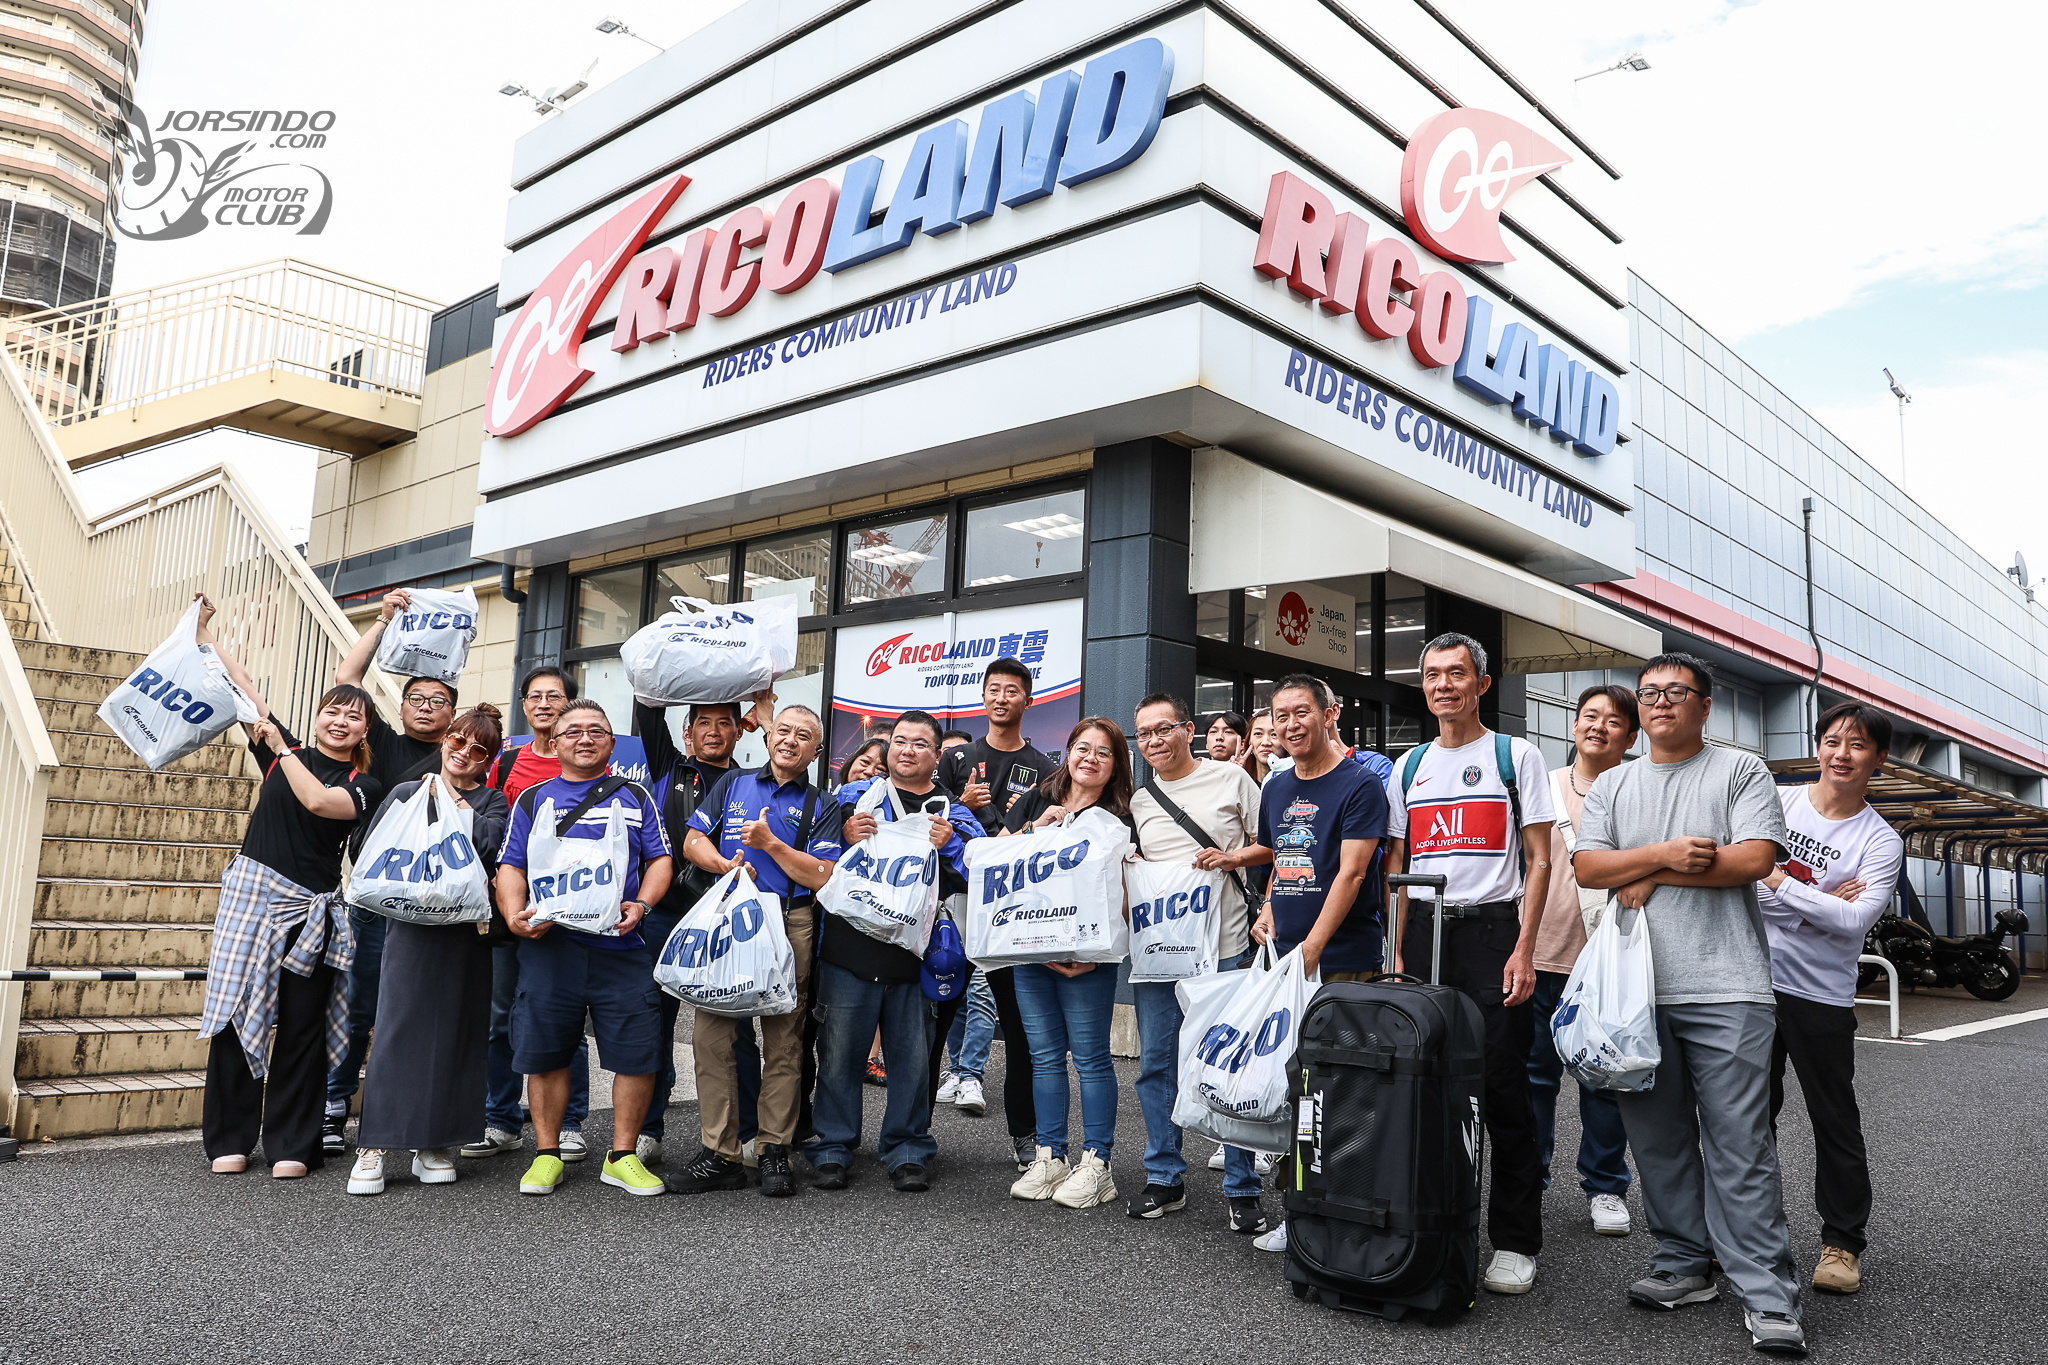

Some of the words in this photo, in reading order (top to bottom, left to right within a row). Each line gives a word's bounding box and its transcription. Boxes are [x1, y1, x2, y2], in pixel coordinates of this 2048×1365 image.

[610, 37, 1175, 354] RICOLAND
[703, 342, 776, 389] RIDERS
[781, 287, 939, 364] COMMUNITY
[940, 263, 1017, 313] LAND
[1253, 170, 1620, 457] RICOLAND
[1284, 349, 1387, 430] RIDERS
[1395, 405, 1540, 502] COMMUNITY
[1543, 473, 1593, 528] LAND
[400, 611, 472, 633] RICO
[1320, 604, 1347, 622] Japan.
[1317, 620, 1347, 639] Tax-free
[413, 647, 448, 660] RICOLAND
[899, 638, 995, 665] RICOLAND
[1328, 638, 1347, 655] Shop
[961, 672, 984, 686] BAY
[129, 667, 214, 724] RICO
[132, 713, 158, 743] RICOLAND
[609, 760, 647, 782] Asahi
[1786, 828, 1841, 860] HICAGO
[532, 859, 613, 904] RICO
[983, 839, 1091, 905] RICO
[403, 902, 464, 914] RICOLAND
[867, 898, 917, 926] RICOLAND
[1014, 905, 1078, 920] RICOLAND
[1132, 885, 1211, 934] RICO
[697, 980, 754, 998] RICOLAND
[1210, 1093, 1259, 1112] RICOLAND
